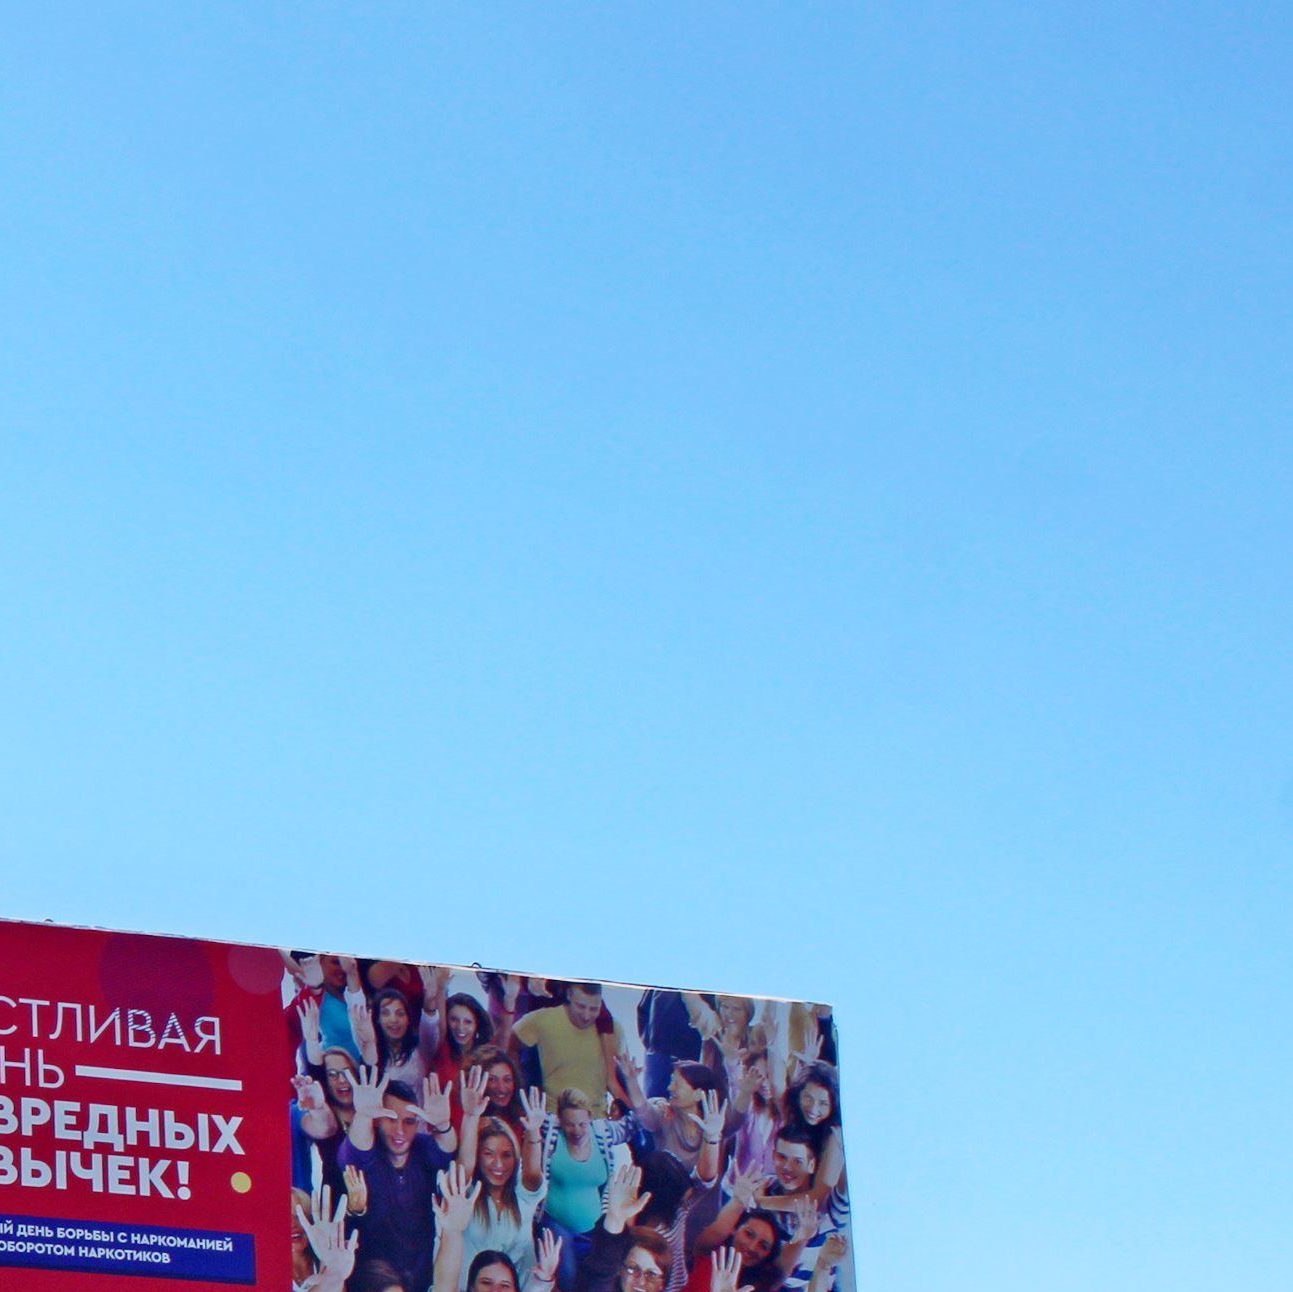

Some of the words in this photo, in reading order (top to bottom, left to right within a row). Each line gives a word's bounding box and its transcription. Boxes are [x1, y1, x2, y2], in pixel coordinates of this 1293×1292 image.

[16, 1223, 54, 1239] ДЕНЬ
[56, 1227, 115, 1243] БОРЬБЫ
[117, 1231, 128, 1244] С
[131, 1232, 233, 1252] НАРКОМАНИЕЙ
[78, 1246, 171, 1264] НАРКОТИКОВ
